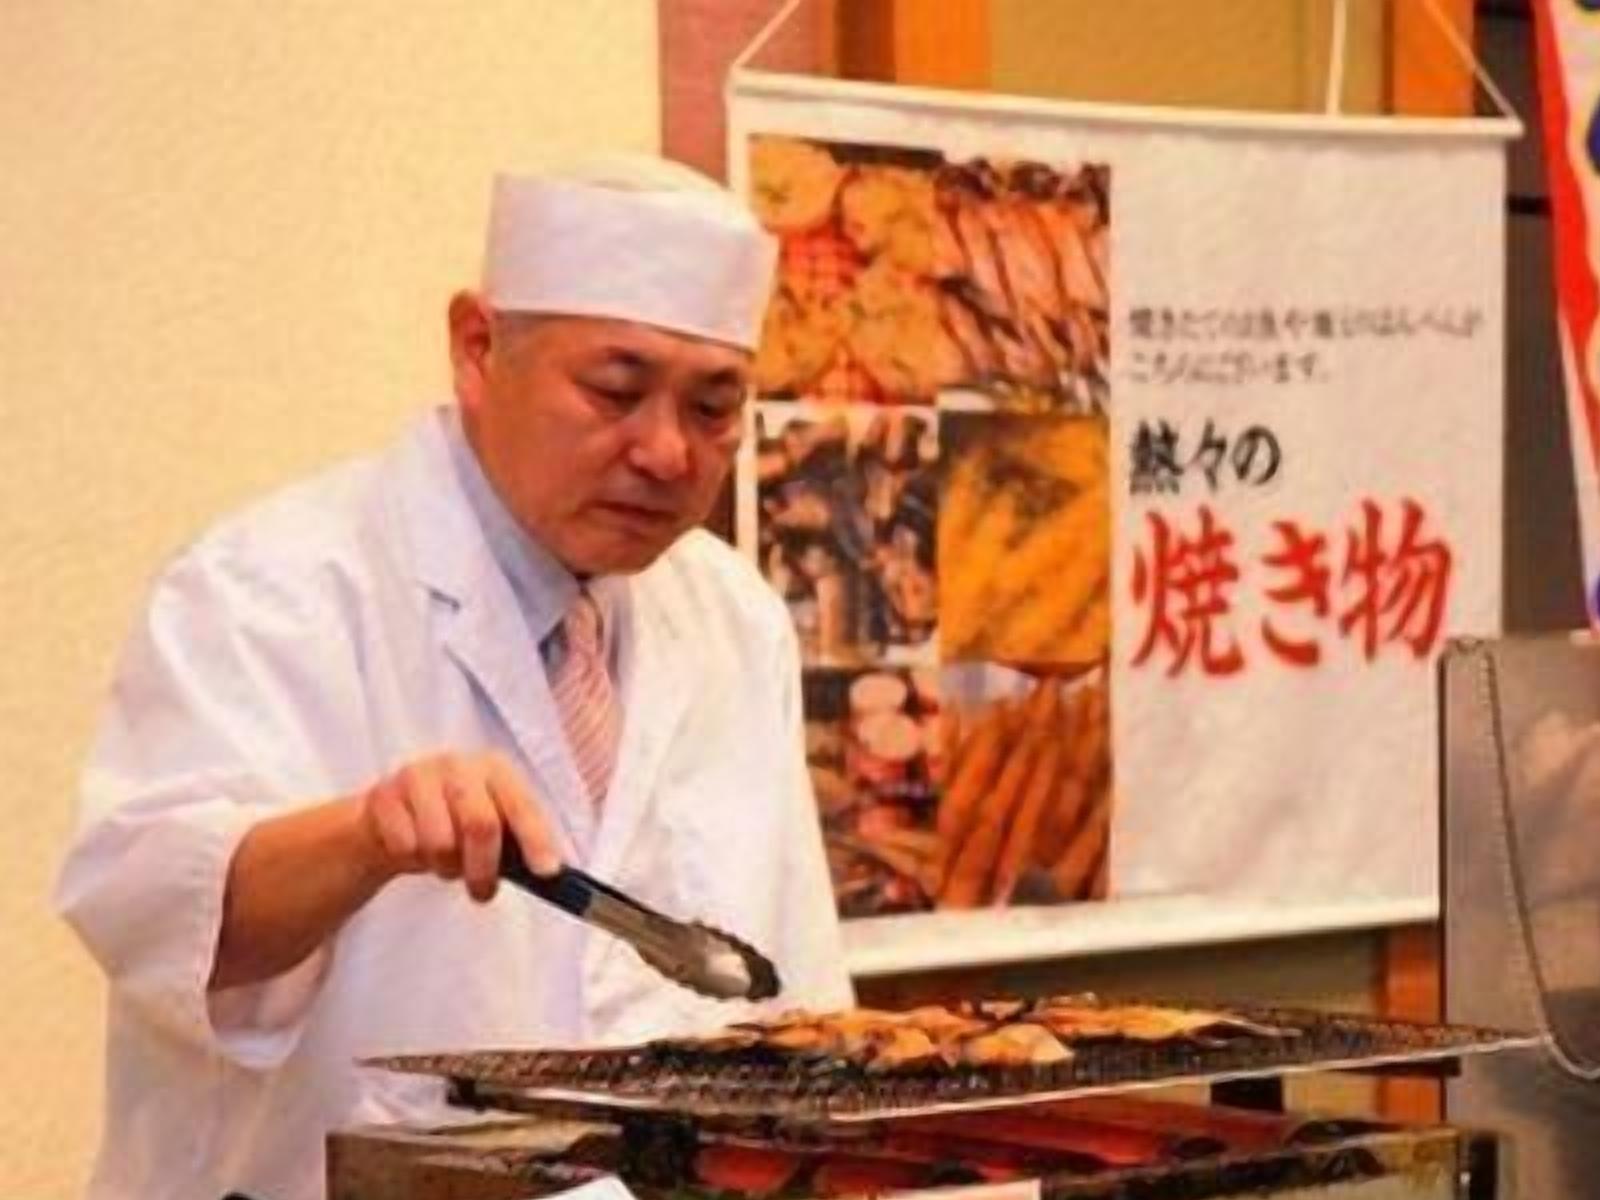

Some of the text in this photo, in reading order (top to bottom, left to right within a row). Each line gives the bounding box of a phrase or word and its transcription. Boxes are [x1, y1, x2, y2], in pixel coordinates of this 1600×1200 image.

[1130, 418, 1282, 495] 熱々の
[1130, 497, 1452, 678] 焼き物
